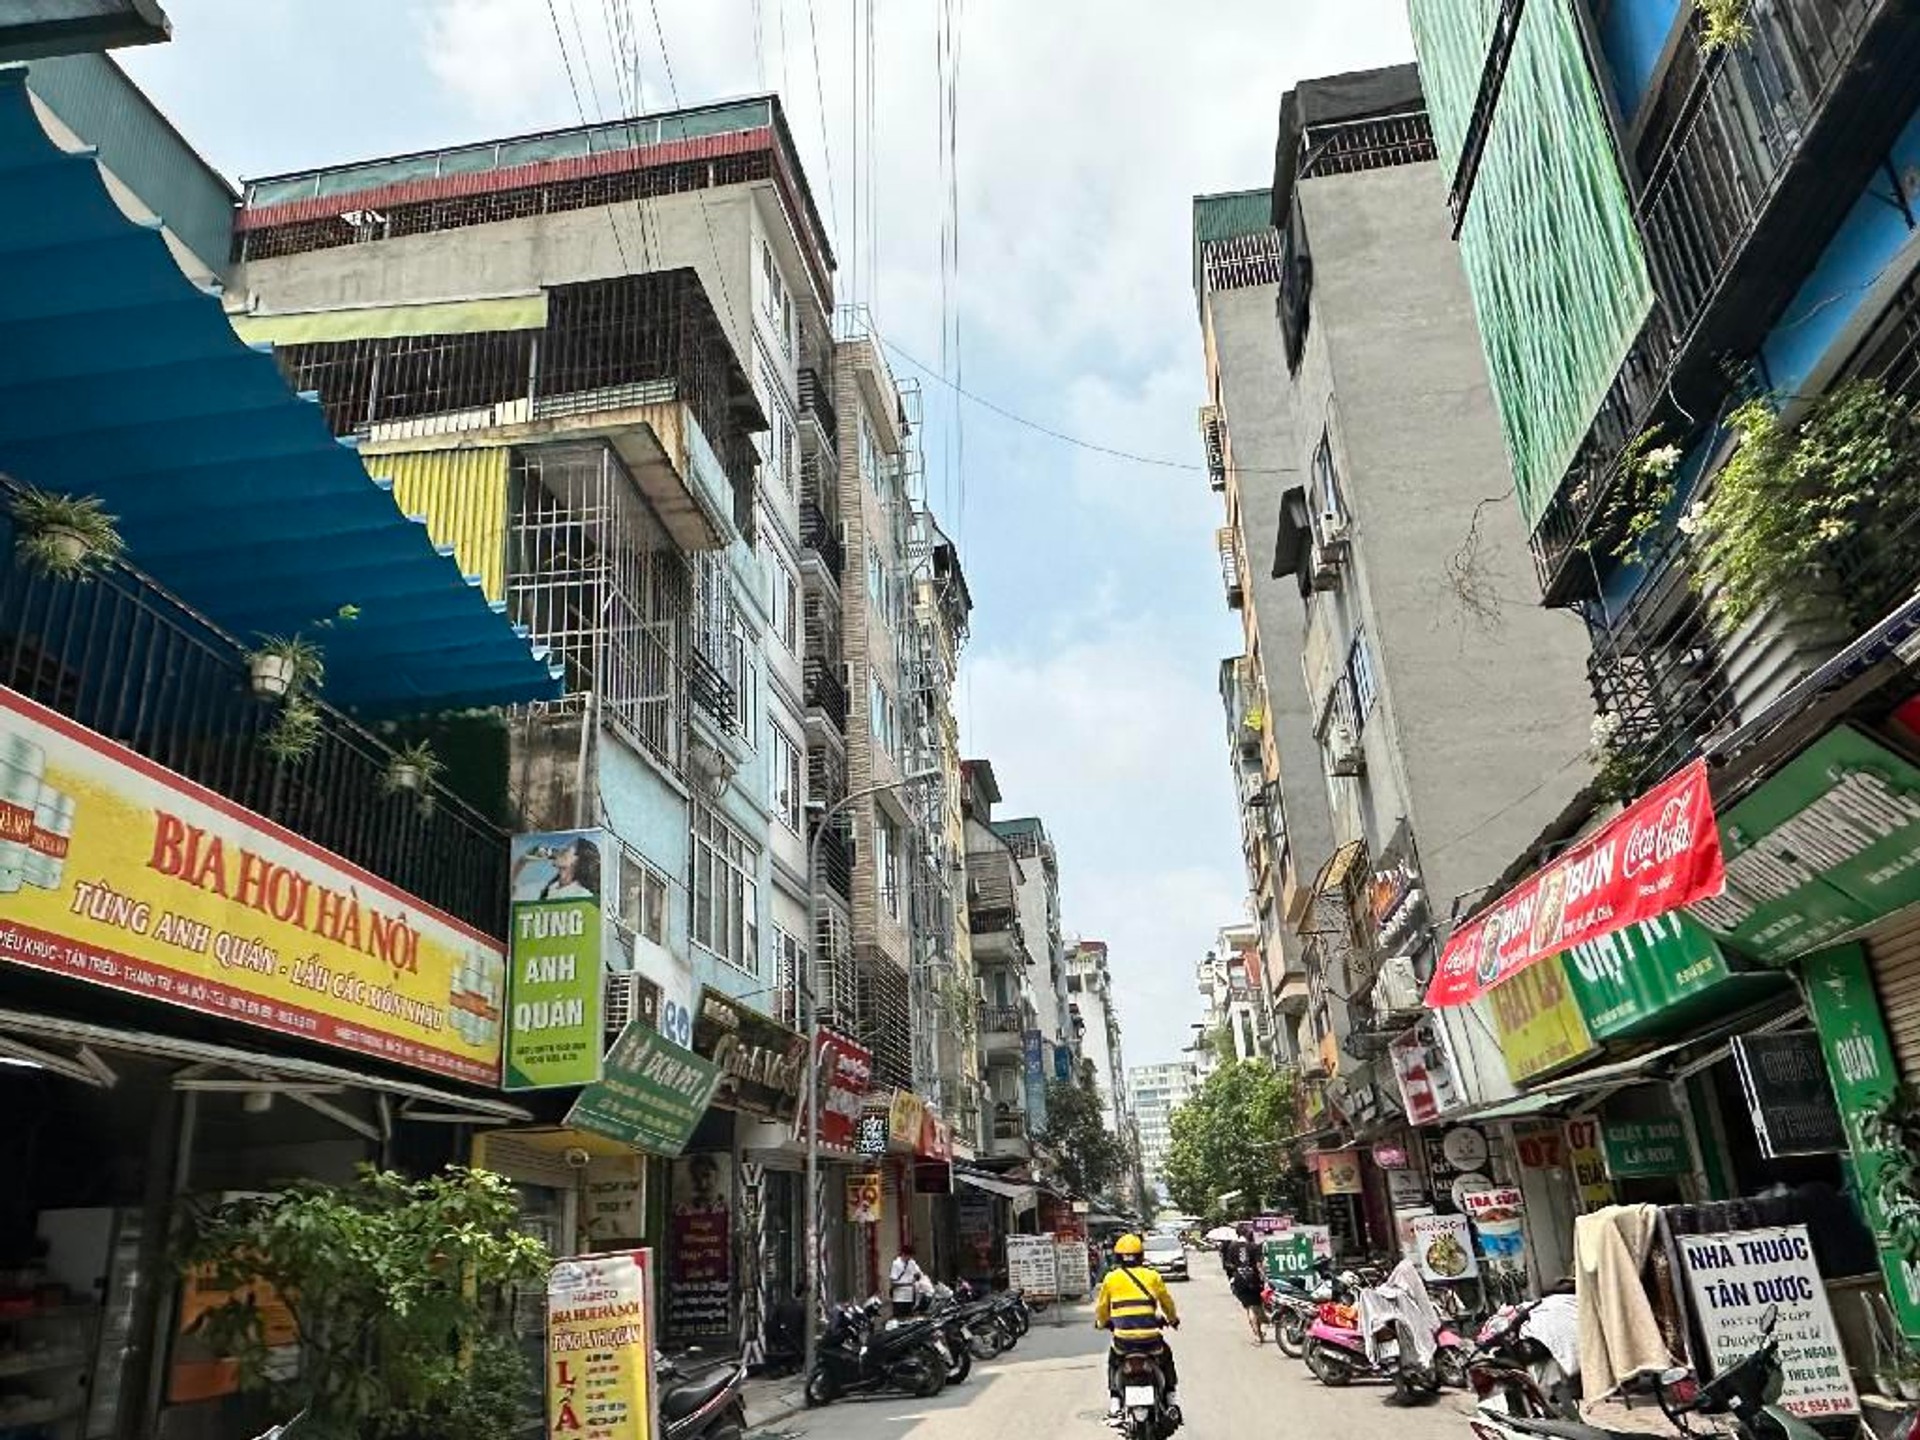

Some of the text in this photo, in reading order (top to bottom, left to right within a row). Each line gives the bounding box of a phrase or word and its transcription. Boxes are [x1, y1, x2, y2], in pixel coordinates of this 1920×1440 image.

[147, 810, 421, 980] BIA HƠI HÀ NỘI
[70, 878, 151, 935] TÙNG
[151, 911, 211, 955] ANH
[213, 930, 278, 976] QUÁN
[517, 905, 584, 939] TÙNG
[524, 952, 576, 985] ANH
[513, 993, 584, 1034] QUÁN
[1737, 1229, 1809, 1266] THUỐC
[1704, 1279, 1751, 1309] TÂN
